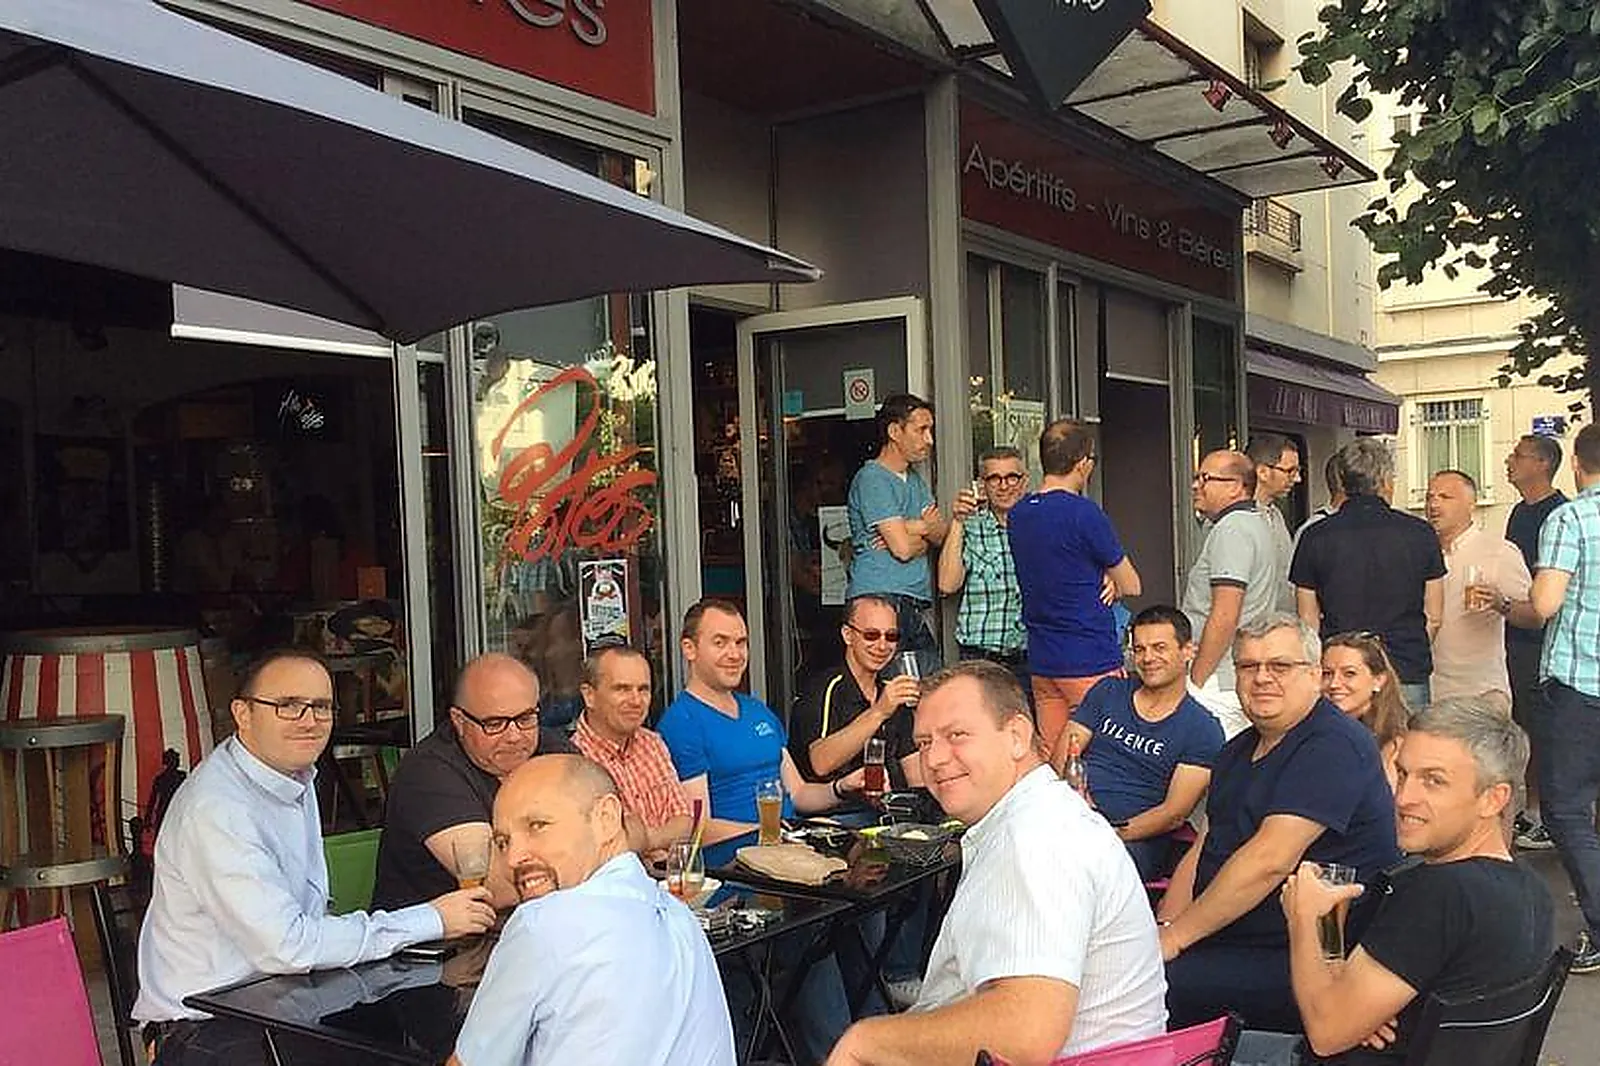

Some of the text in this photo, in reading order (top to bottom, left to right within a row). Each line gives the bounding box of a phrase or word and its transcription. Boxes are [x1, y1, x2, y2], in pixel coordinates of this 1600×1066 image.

[964, 142, 1077, 212] Apéritifs
[1105, 198, 1150, 239] Vins
[1101, 717, 1165, 756] SILENCE
